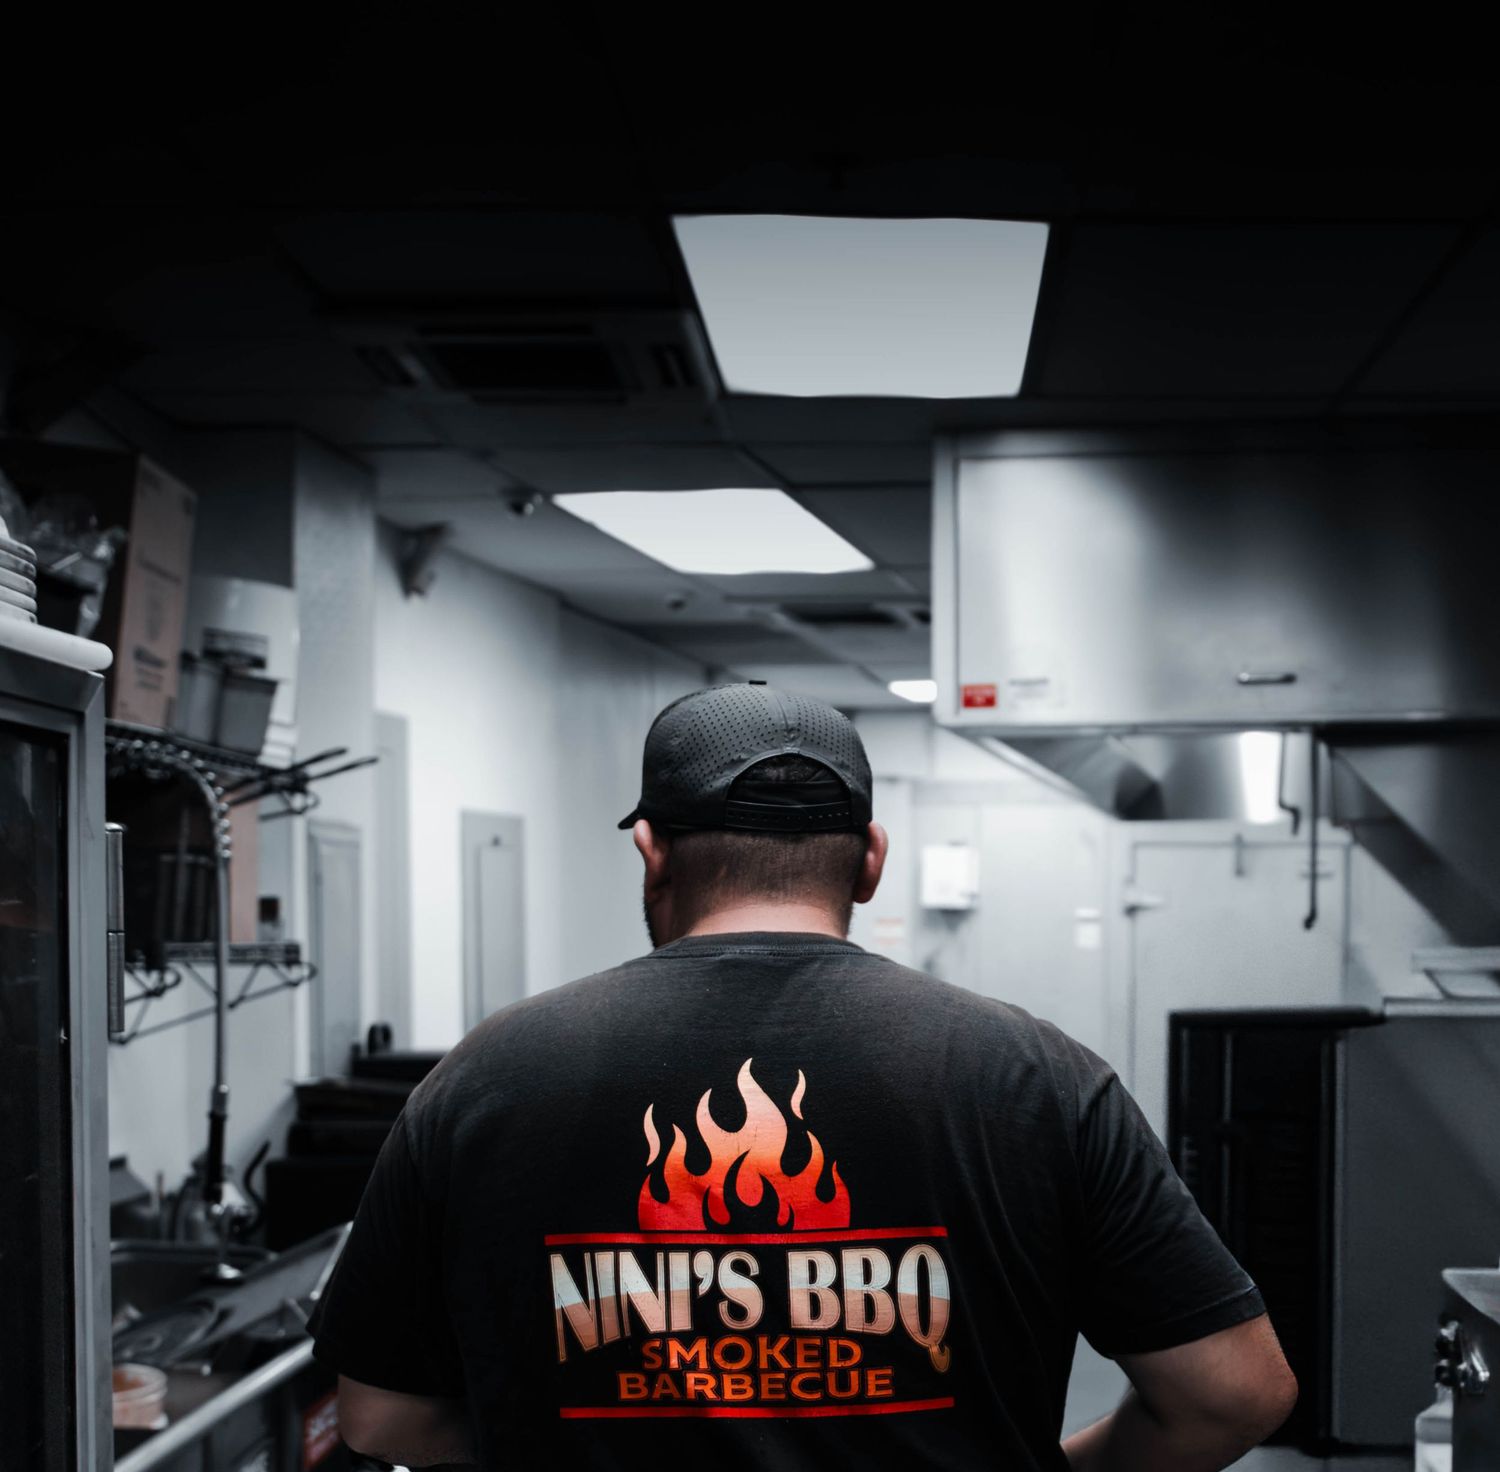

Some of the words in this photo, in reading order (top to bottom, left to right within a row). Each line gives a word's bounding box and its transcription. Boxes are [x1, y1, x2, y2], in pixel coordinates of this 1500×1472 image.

[549, 1249, 767, 1365] NINI'S
[786, 1244, 952, 1374] BBQ
[640, 1335, 864, 1370] SMOKED
[616, 1367, 896, 1402] BARBECUE
